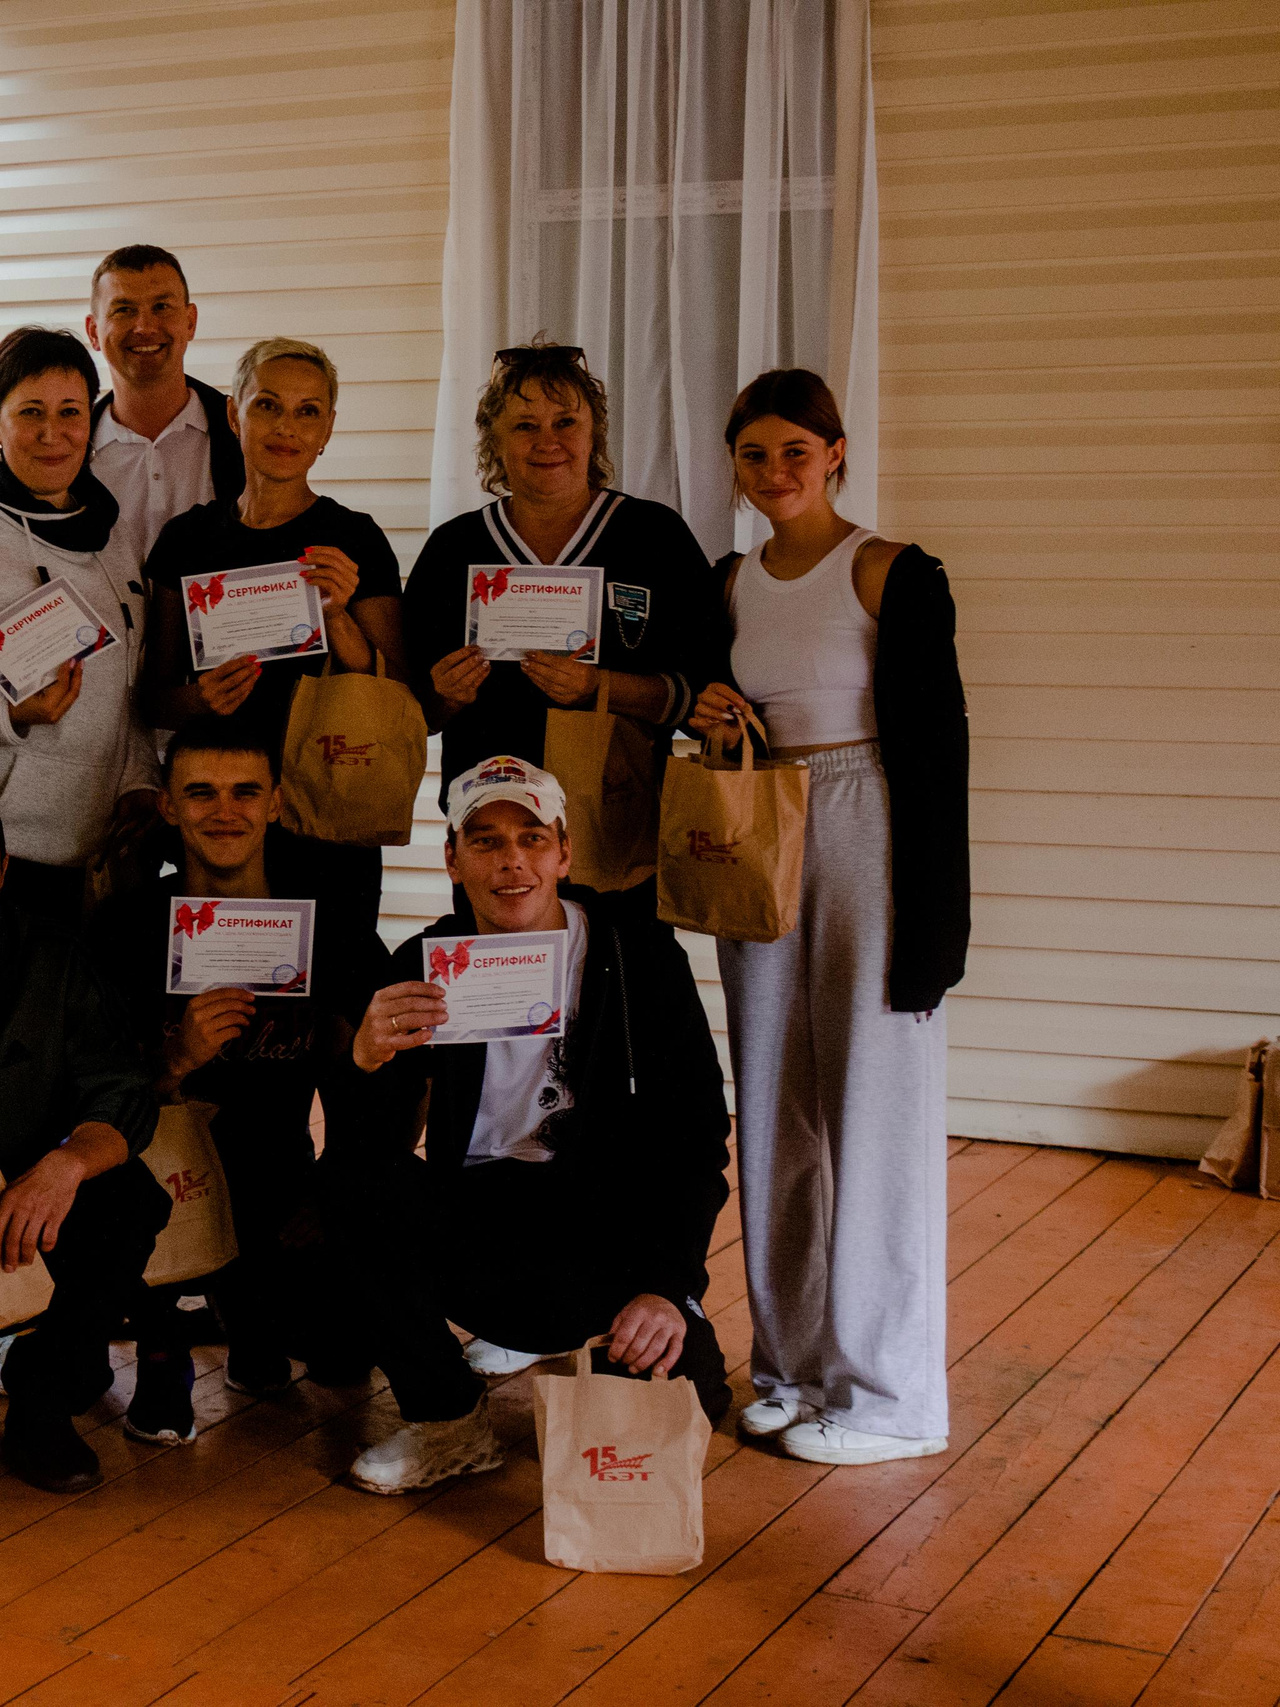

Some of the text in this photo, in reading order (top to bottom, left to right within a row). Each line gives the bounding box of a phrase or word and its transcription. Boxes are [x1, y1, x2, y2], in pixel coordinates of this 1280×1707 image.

[227, 579, 298, 598] СЕРТИФИКАТ
[510, 584, 583, 596] СЕРТИФИКАТ
[6, 596, 65, 635] СЕРТИФИКАТ
[316, 735, 347, 761] 15
[687, 829, 711, 856] 15
[217, 917, 293, 929] СЕРТИФИКАТ
[473, 953, 548, 969] СЕРТИФИКАТ
[165, 1169, 193, 1200] 15
[581, 1445, 618, 1478] 15
[597, 1471, 655, 1482] БЭТ
